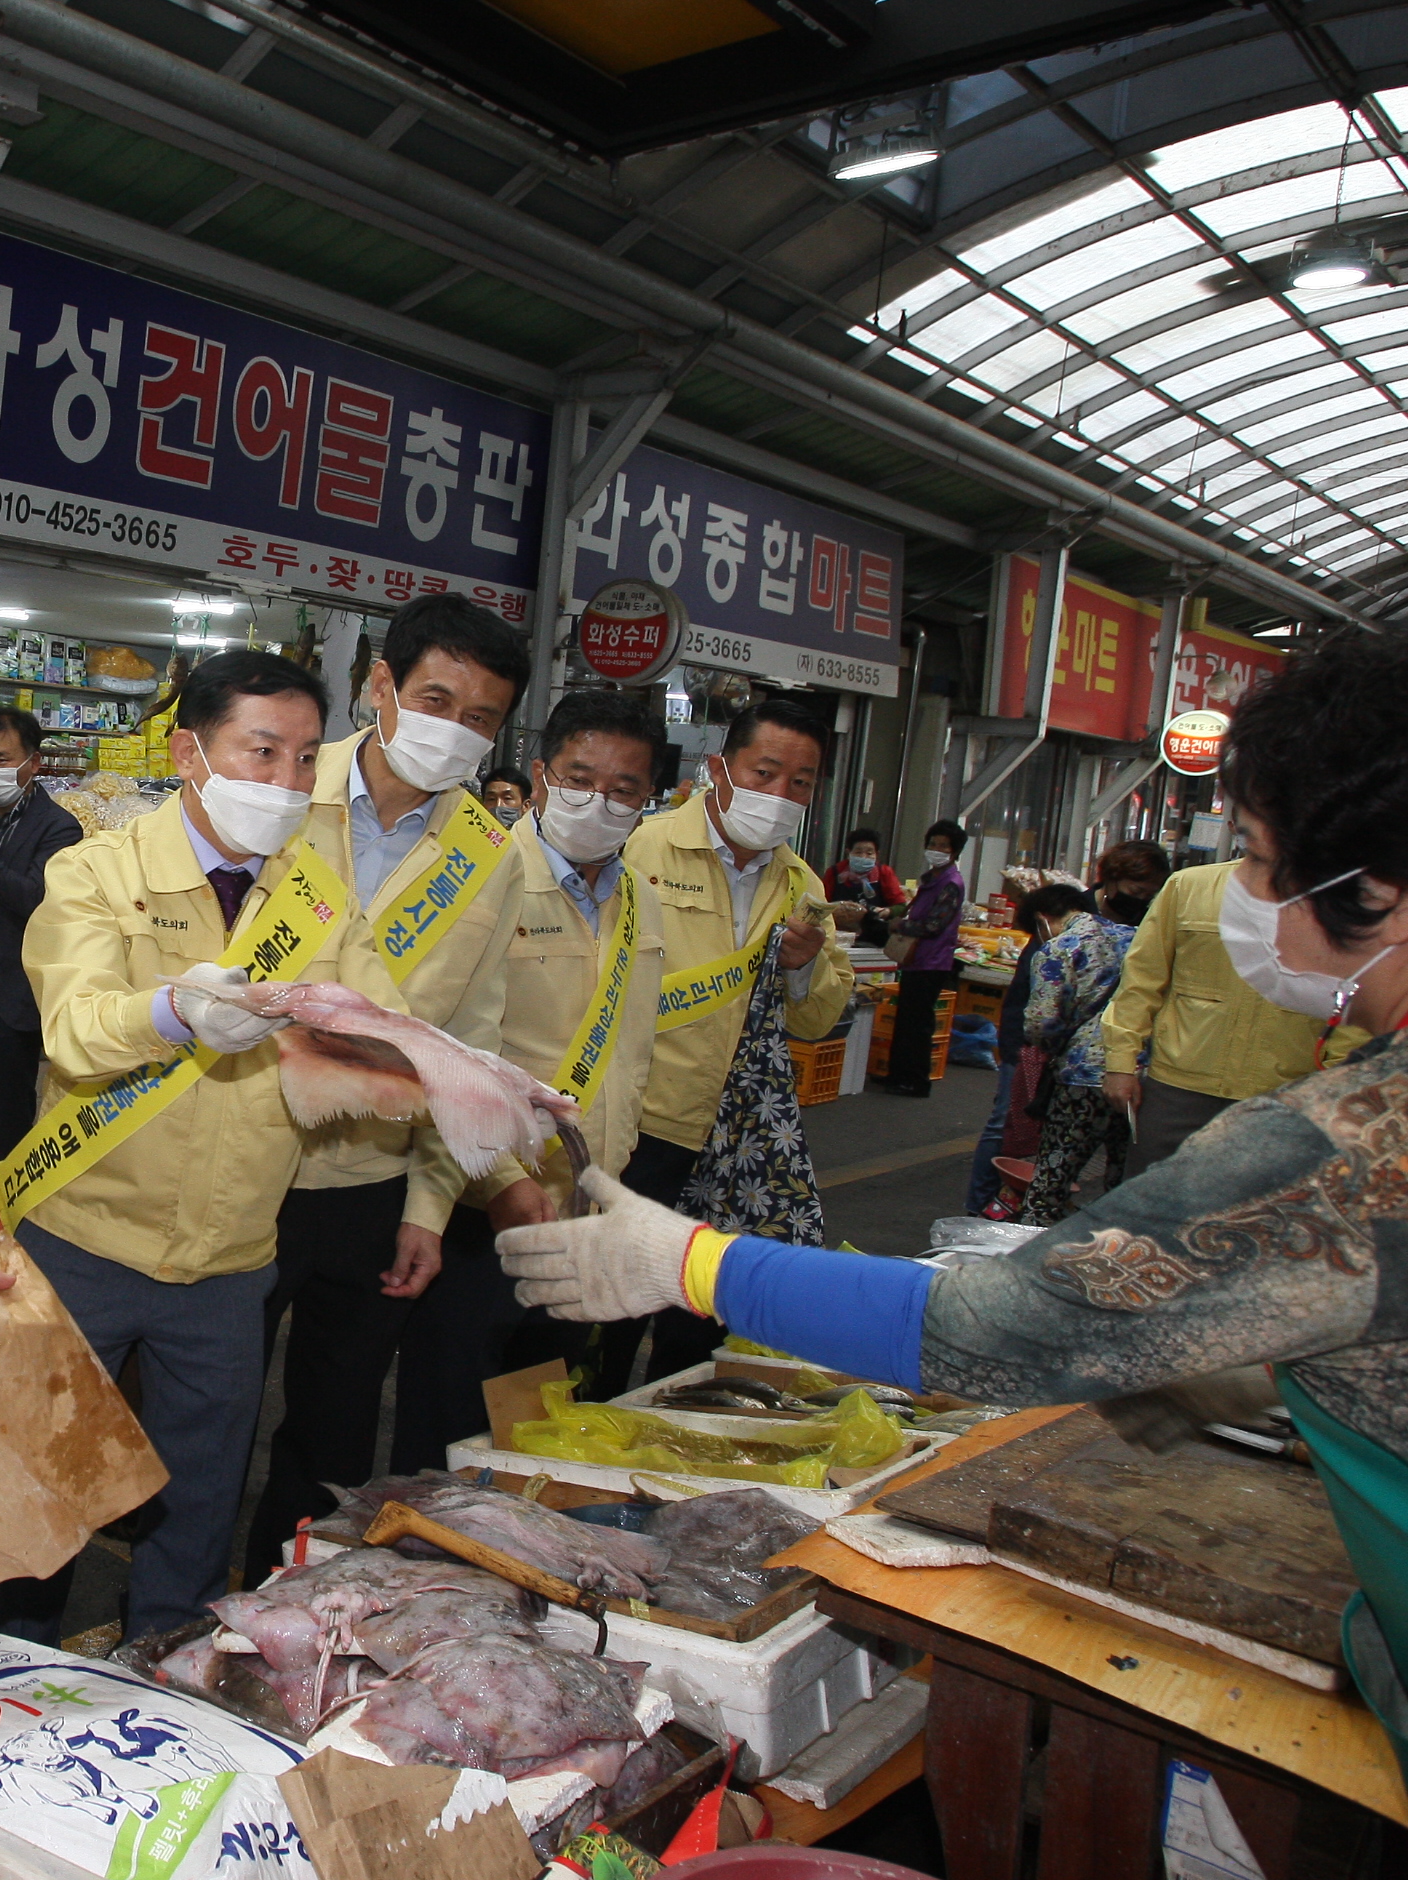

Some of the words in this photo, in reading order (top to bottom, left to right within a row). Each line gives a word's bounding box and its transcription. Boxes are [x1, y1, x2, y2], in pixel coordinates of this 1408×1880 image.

[588, 622, 661, 649] 화성수퍼
[816, 656, 881, 687] 633-8555
[384, 847, 477, 960] 전통시장
[3, 1121, 82, 1210] 애용합시다
